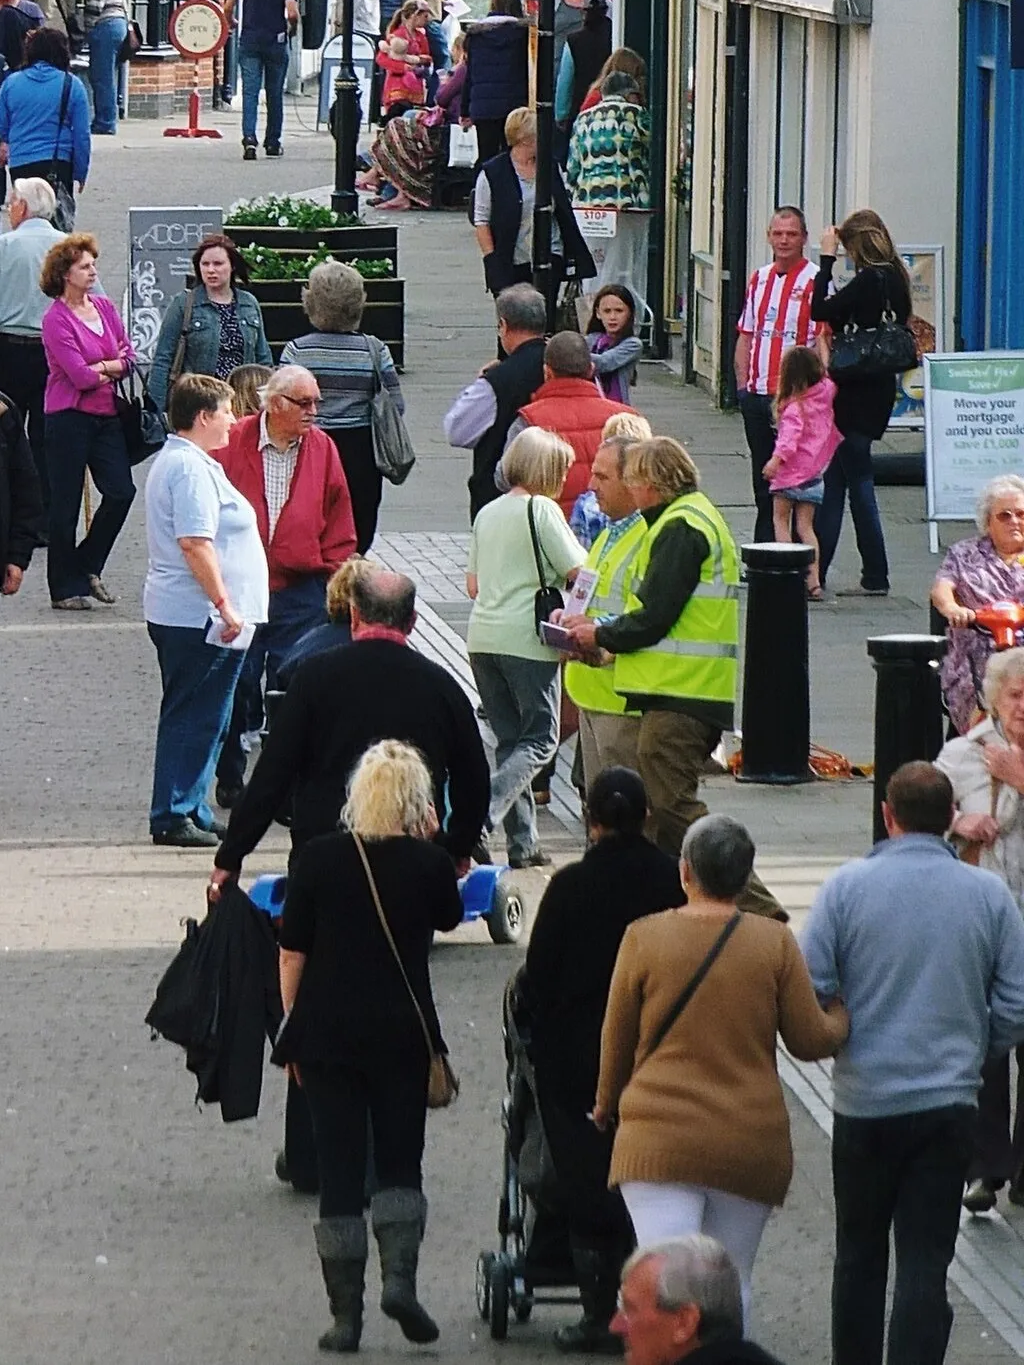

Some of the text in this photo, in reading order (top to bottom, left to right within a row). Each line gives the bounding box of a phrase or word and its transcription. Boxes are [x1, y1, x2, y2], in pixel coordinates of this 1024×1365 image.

[584, 211, 608, 220] STOP
[954, 398, 1016, 412] Move your
[956, 412, 1015, 425] mortgage
[945, 426, 967, 436] and
[969, 429, 993, 440] you
